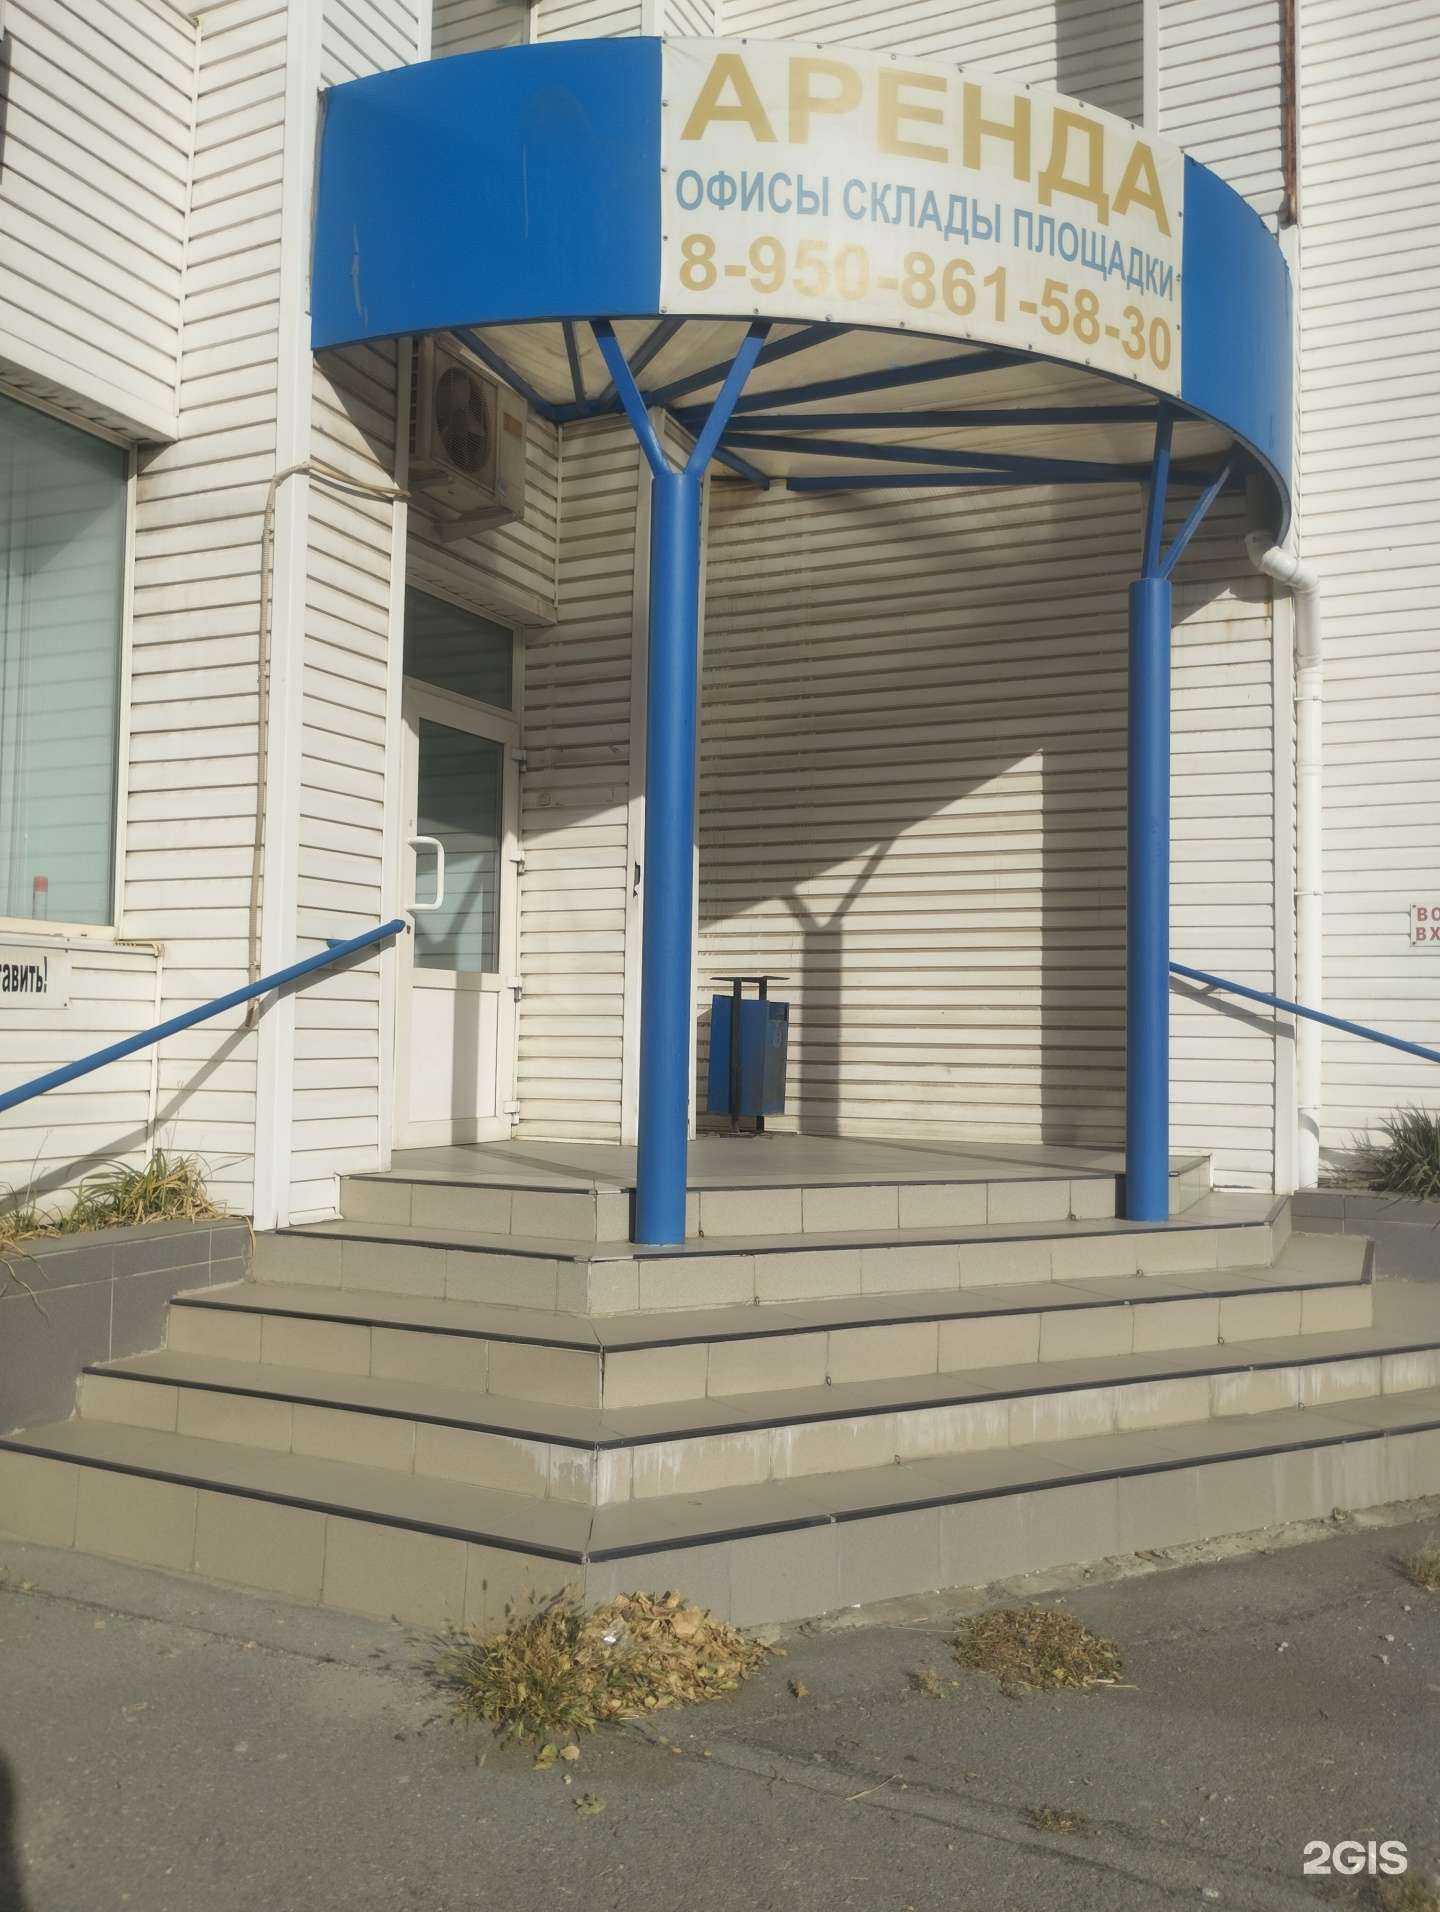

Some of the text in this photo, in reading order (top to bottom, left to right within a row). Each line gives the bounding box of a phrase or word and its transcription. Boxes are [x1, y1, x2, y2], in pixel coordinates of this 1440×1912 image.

[680, 52, 1172, 238] АРЕНДА
[675, 170, 1174, 302] ОФИСЫ СКЛАДЫ ПЛОЩАДКИ
[679, 233, 1171, 371] 8-950-861-58-30
[0, 955, 47, 993] авить!
